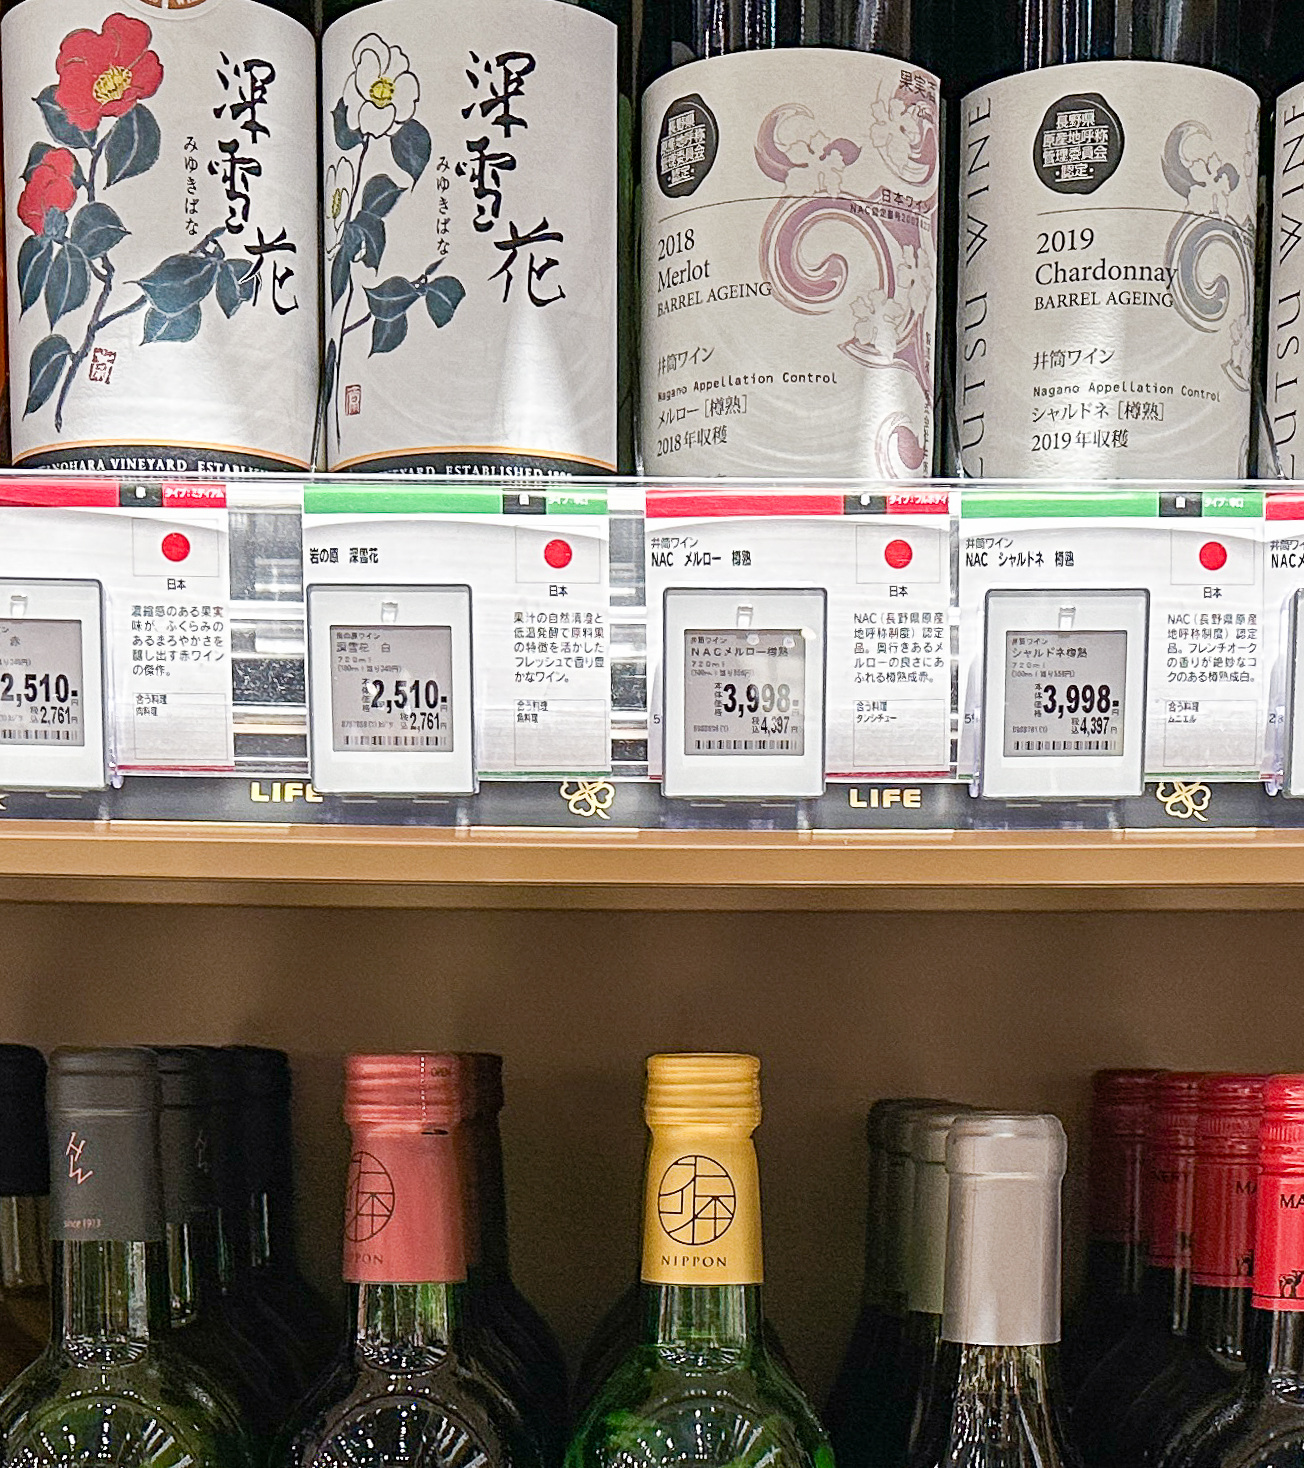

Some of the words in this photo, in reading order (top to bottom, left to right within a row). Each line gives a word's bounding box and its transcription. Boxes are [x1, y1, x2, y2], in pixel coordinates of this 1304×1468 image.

[184, 136, 199, 237] みゆきばな
[207, 50, 299, 315] 深雪花
[456, 50, 566, 308] 深雪花
[435, 155, 450, 255] みゆきばな
[657, 228, 695, 261] 2018
[1036, 227, 1094, 255] 2019
[656, 260, 710, 293] Merlot
[1035, 261, 1179, 292] Chardonnay
[657, 289, 703, 318] BARREL
[707, 280, 773, 304] AGEING
[1035, 291, 1101, 311] BARREL
[1107, 291, 1173, 308] AGEING
[1033, 347, 1115, 369] 井筒ワイン
[1033, 384, 1081, 397] Nagano
[1089, 381, 1173, 396] Appellation
[1181, 387, 1221, 402] Control
[656, 427, 727, 458] 2018年収穫
[1032, 428, 1129, 452] 2019年収穫
[651, 537, 698, 549] 井筒ワイン
[966, 538, 1013, 549] 井筒ワイン
[167, 579, 186, 590] 日本
[549, 585, 568, 597] 日本
[889, 585, 908, 597] 日本
[1, 673, 70, 707] 2,510
[371, 679, 440, 714] 2,510
[723, 683, 791, 718] 3,998
[1043, 685, 1111, 719] 3,998
[849, 788, 922, 808] LIFE
[661, 1254, 728, 1268] NIPPON
